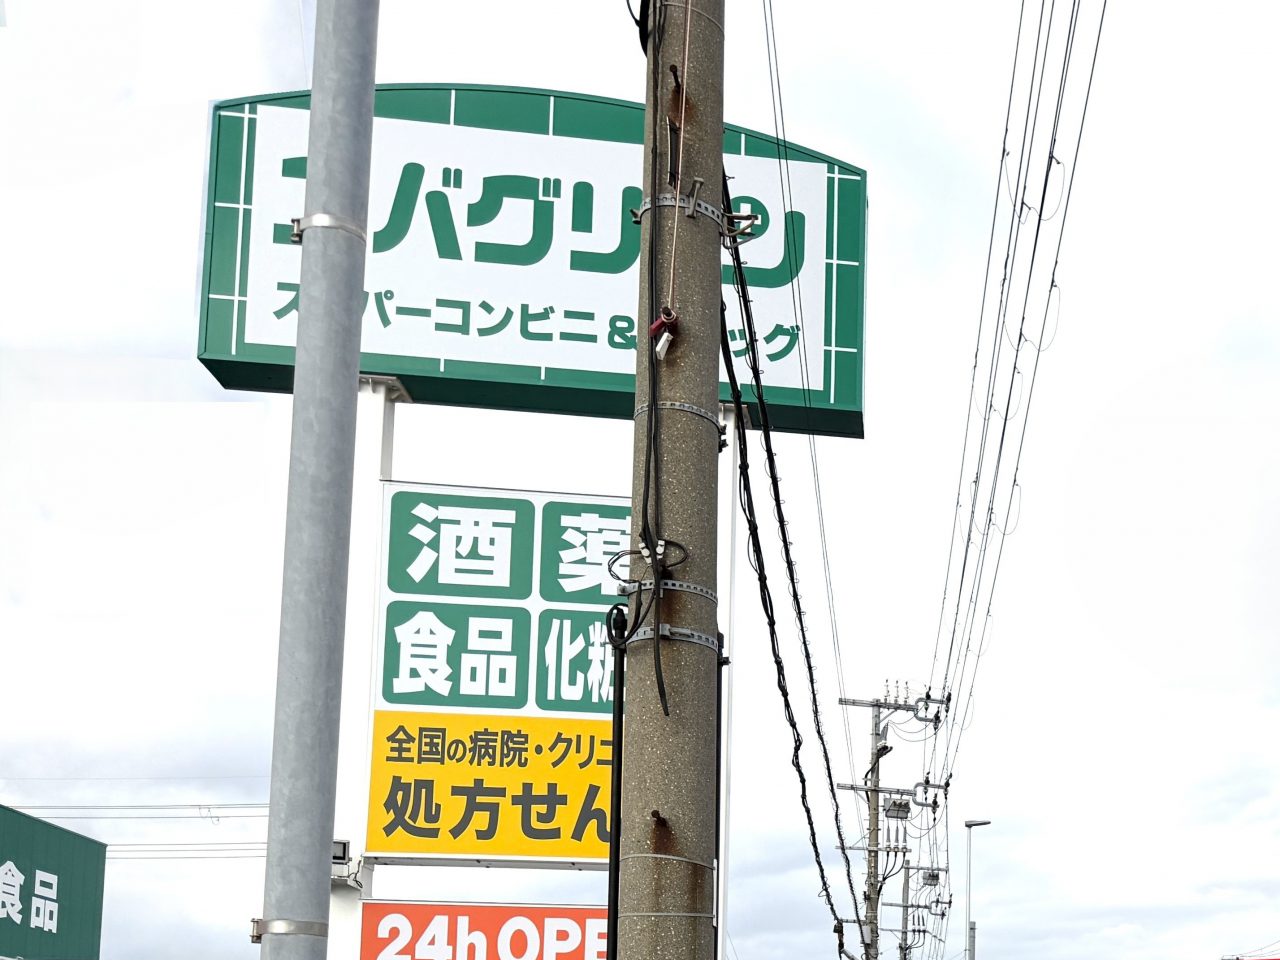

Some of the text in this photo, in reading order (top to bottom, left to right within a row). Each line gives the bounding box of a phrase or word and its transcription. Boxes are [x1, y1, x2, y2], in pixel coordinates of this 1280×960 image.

[406, 502, 516, 587] 酒
[392, 611, 518, 697] 食品
[0, 861, 59, 934] 食品
